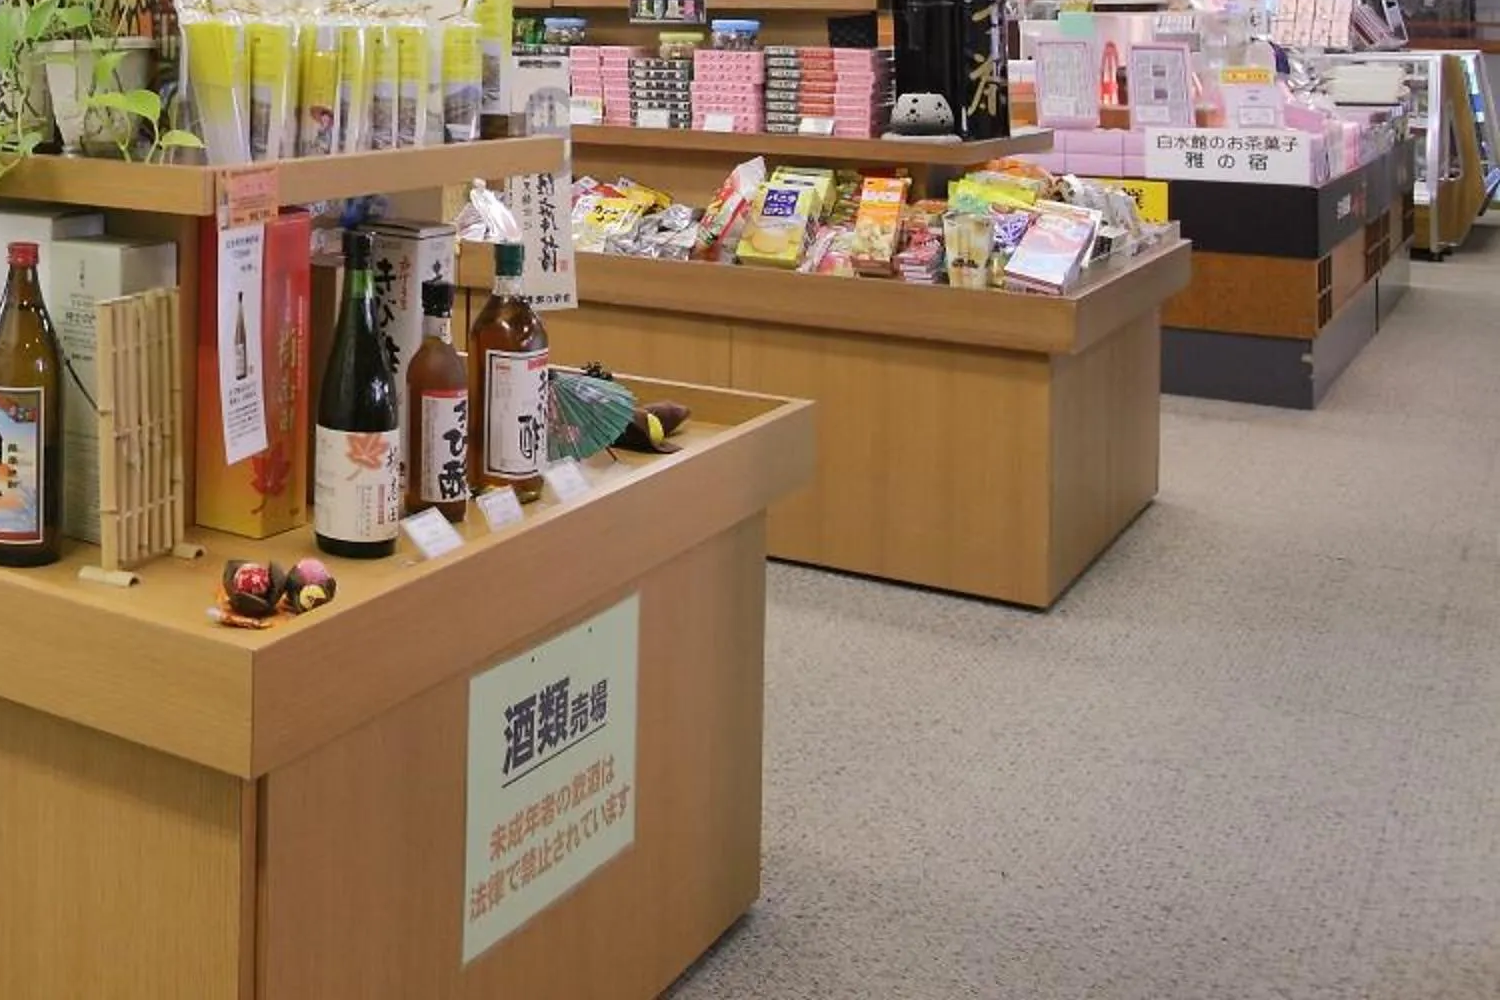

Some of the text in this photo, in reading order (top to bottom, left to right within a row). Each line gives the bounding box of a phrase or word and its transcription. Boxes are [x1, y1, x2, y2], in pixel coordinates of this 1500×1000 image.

[1156, 134, 1299, 152] 白水館のお茶菓子
[1185, 152, 1269, 170] 雅の宿
[502, 676, 608, 775] 酒類売場
[469, 784, 631, 921] 法律で禁止されています
[490, 755, 615, 861] 未成年者の飲酒は
